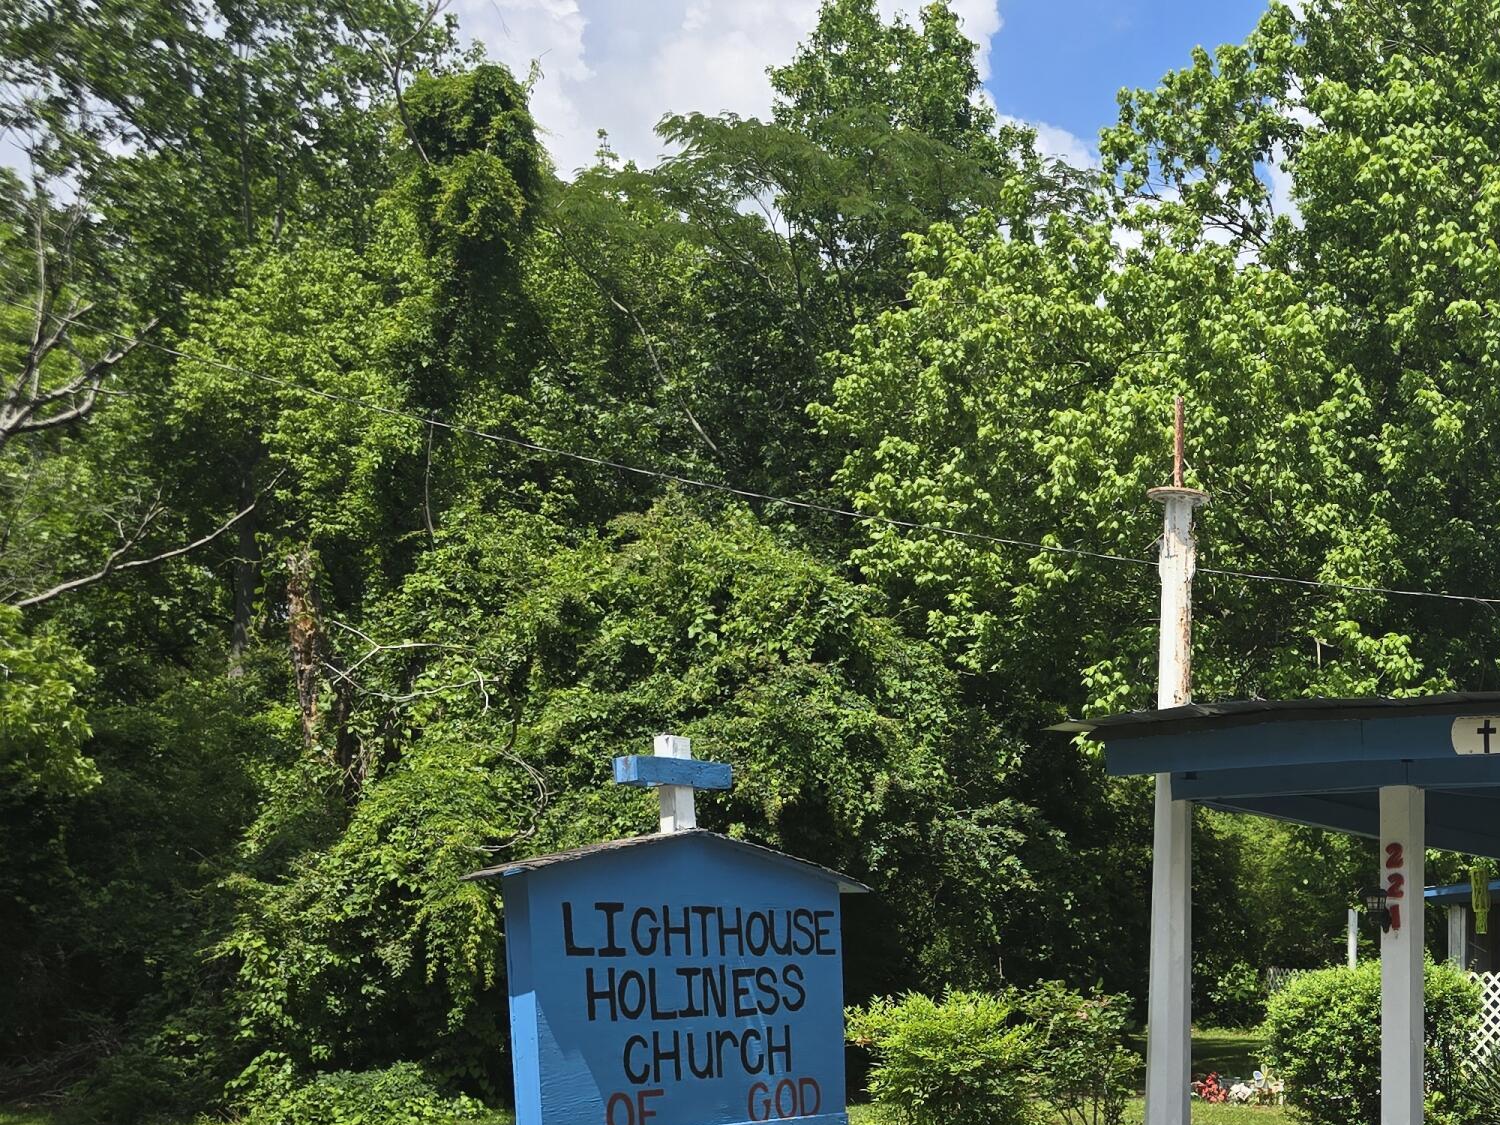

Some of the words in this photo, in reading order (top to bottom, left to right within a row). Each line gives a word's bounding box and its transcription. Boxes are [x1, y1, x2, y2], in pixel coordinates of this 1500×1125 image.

[561, 901, 837, 958] LIGHTHOUSE
[586, 963, 806, 1021] HOLINESS
[747, 1077, 822, 1122] GOD
